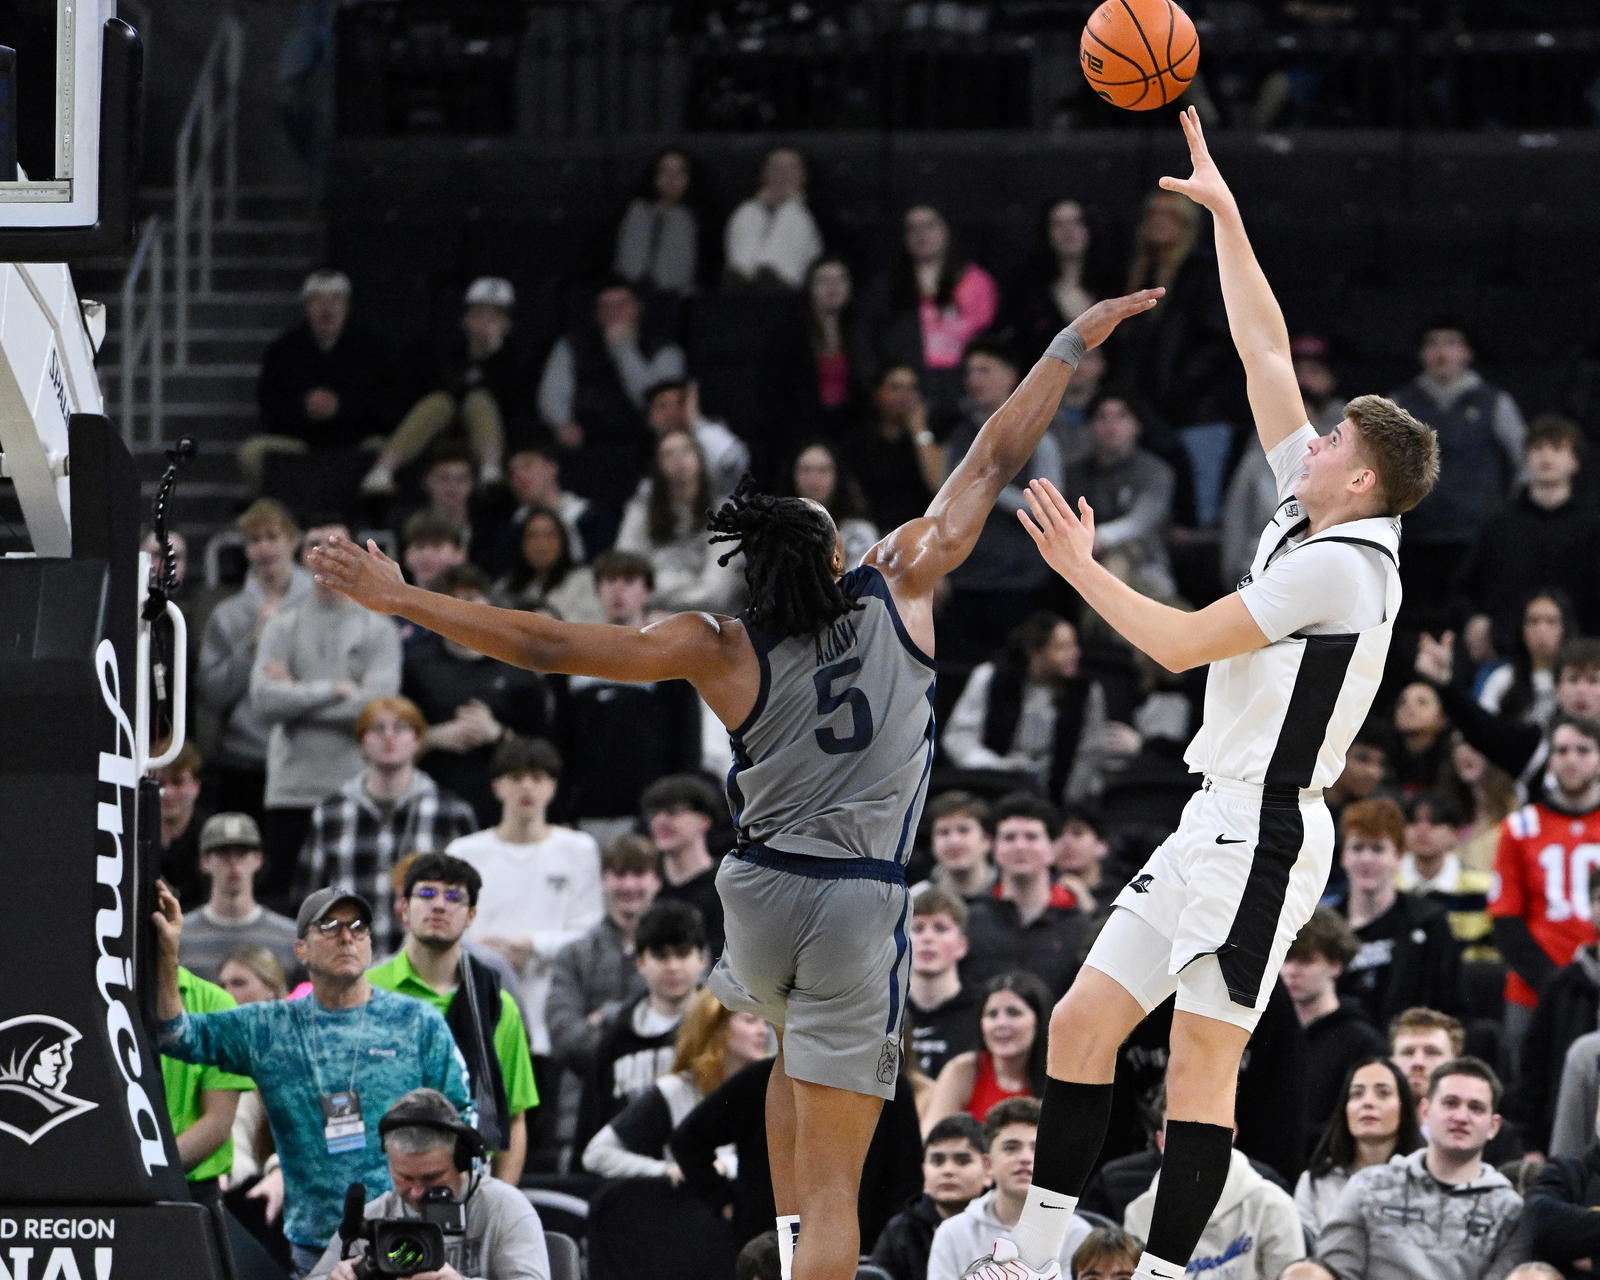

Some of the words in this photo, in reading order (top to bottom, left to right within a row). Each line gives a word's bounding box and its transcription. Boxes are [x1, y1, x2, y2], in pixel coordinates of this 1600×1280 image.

[812, 656, 874, 755] 5
[94, 638, 169, 1178] Amica
[24, 1218, 115, 1239] REGION
